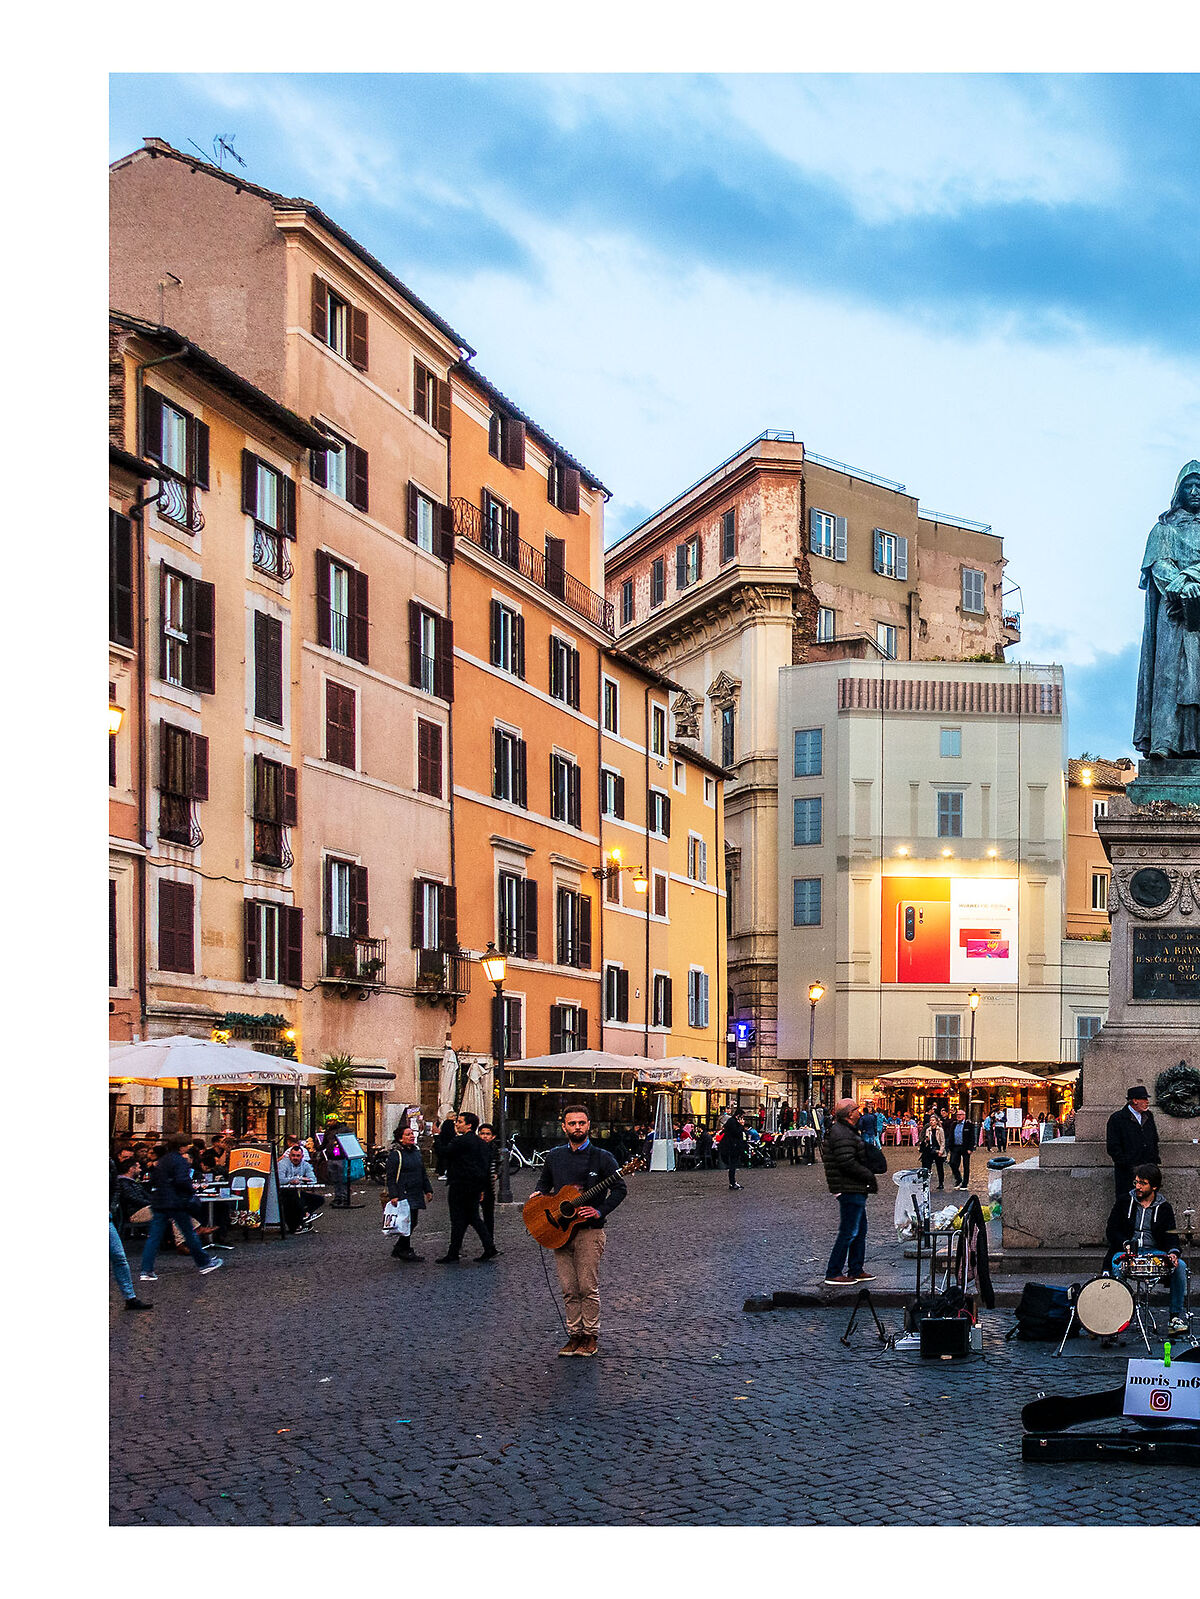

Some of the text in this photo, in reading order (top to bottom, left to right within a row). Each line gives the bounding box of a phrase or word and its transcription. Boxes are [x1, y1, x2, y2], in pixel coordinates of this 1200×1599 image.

[1163, 946, 1169, 955] A
[1177, 964, 1195, 973] QVI
[1129, 1374, 1200, 1390] moris_m6
